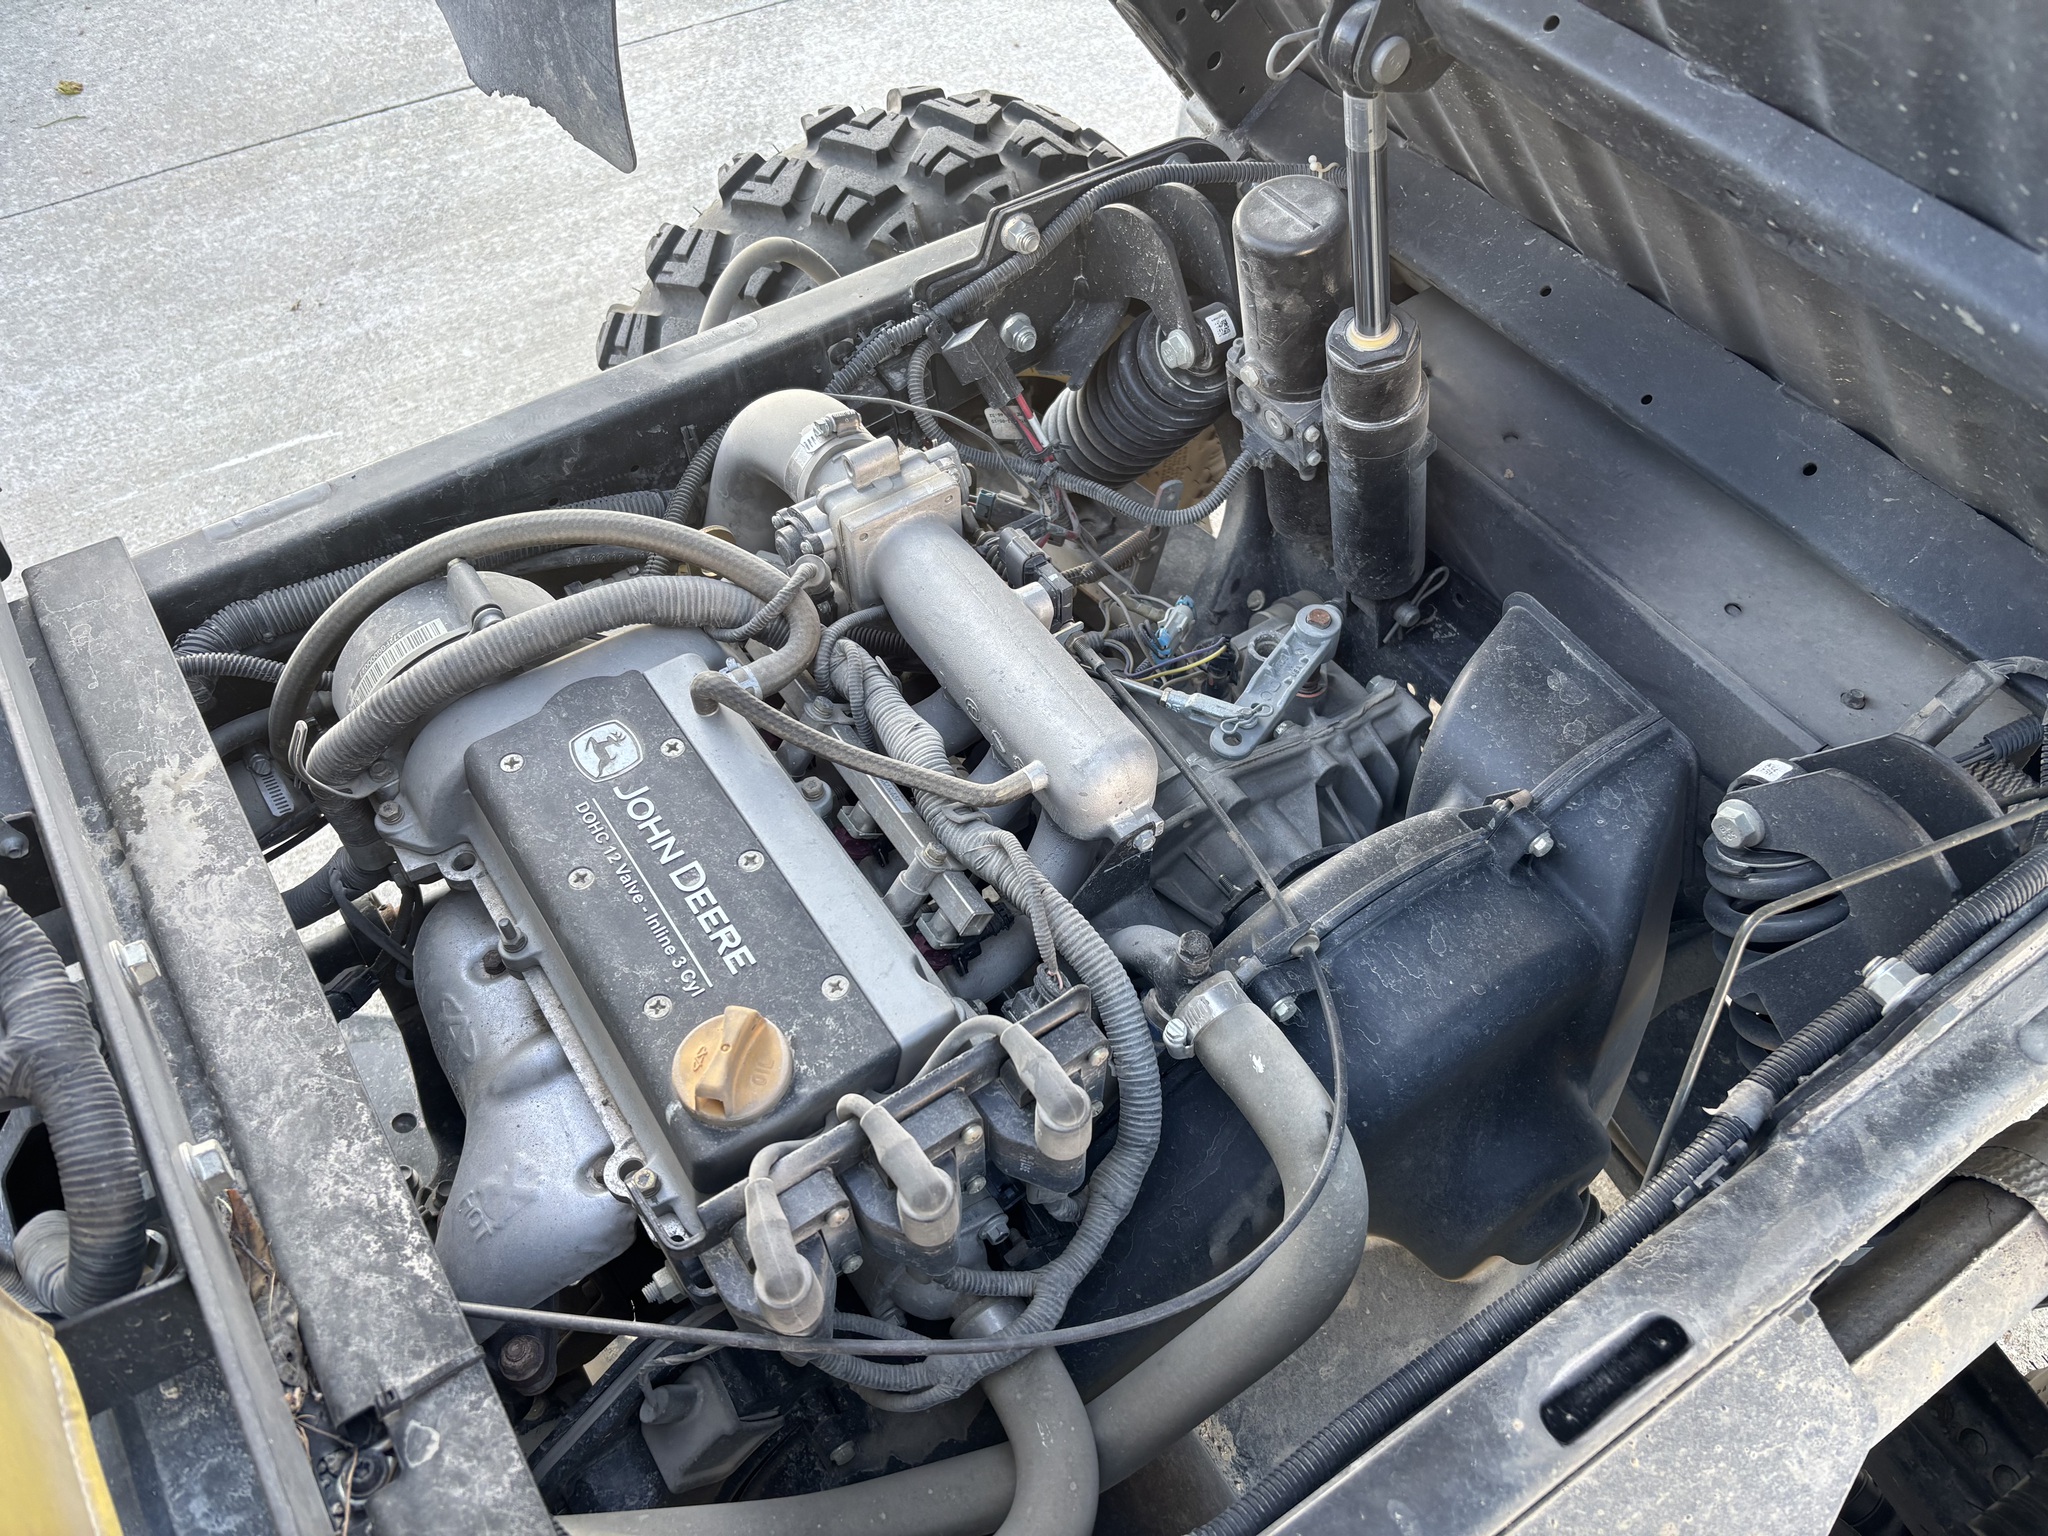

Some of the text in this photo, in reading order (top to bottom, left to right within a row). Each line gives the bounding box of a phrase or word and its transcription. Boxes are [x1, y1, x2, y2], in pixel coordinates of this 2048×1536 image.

[575, 800, 610, 845] DOHC
[603, 844, 623, 865] 12
[615, 862, 645, 905] Valve
[645, 912, 677, 957] Inline
[671, 955, 687, 970] 3
[680, 969, 706, 998] Cyl
[612, 785, 757, 976] JOHN DEERE
[751, 1059, 775, 1086] OIL
